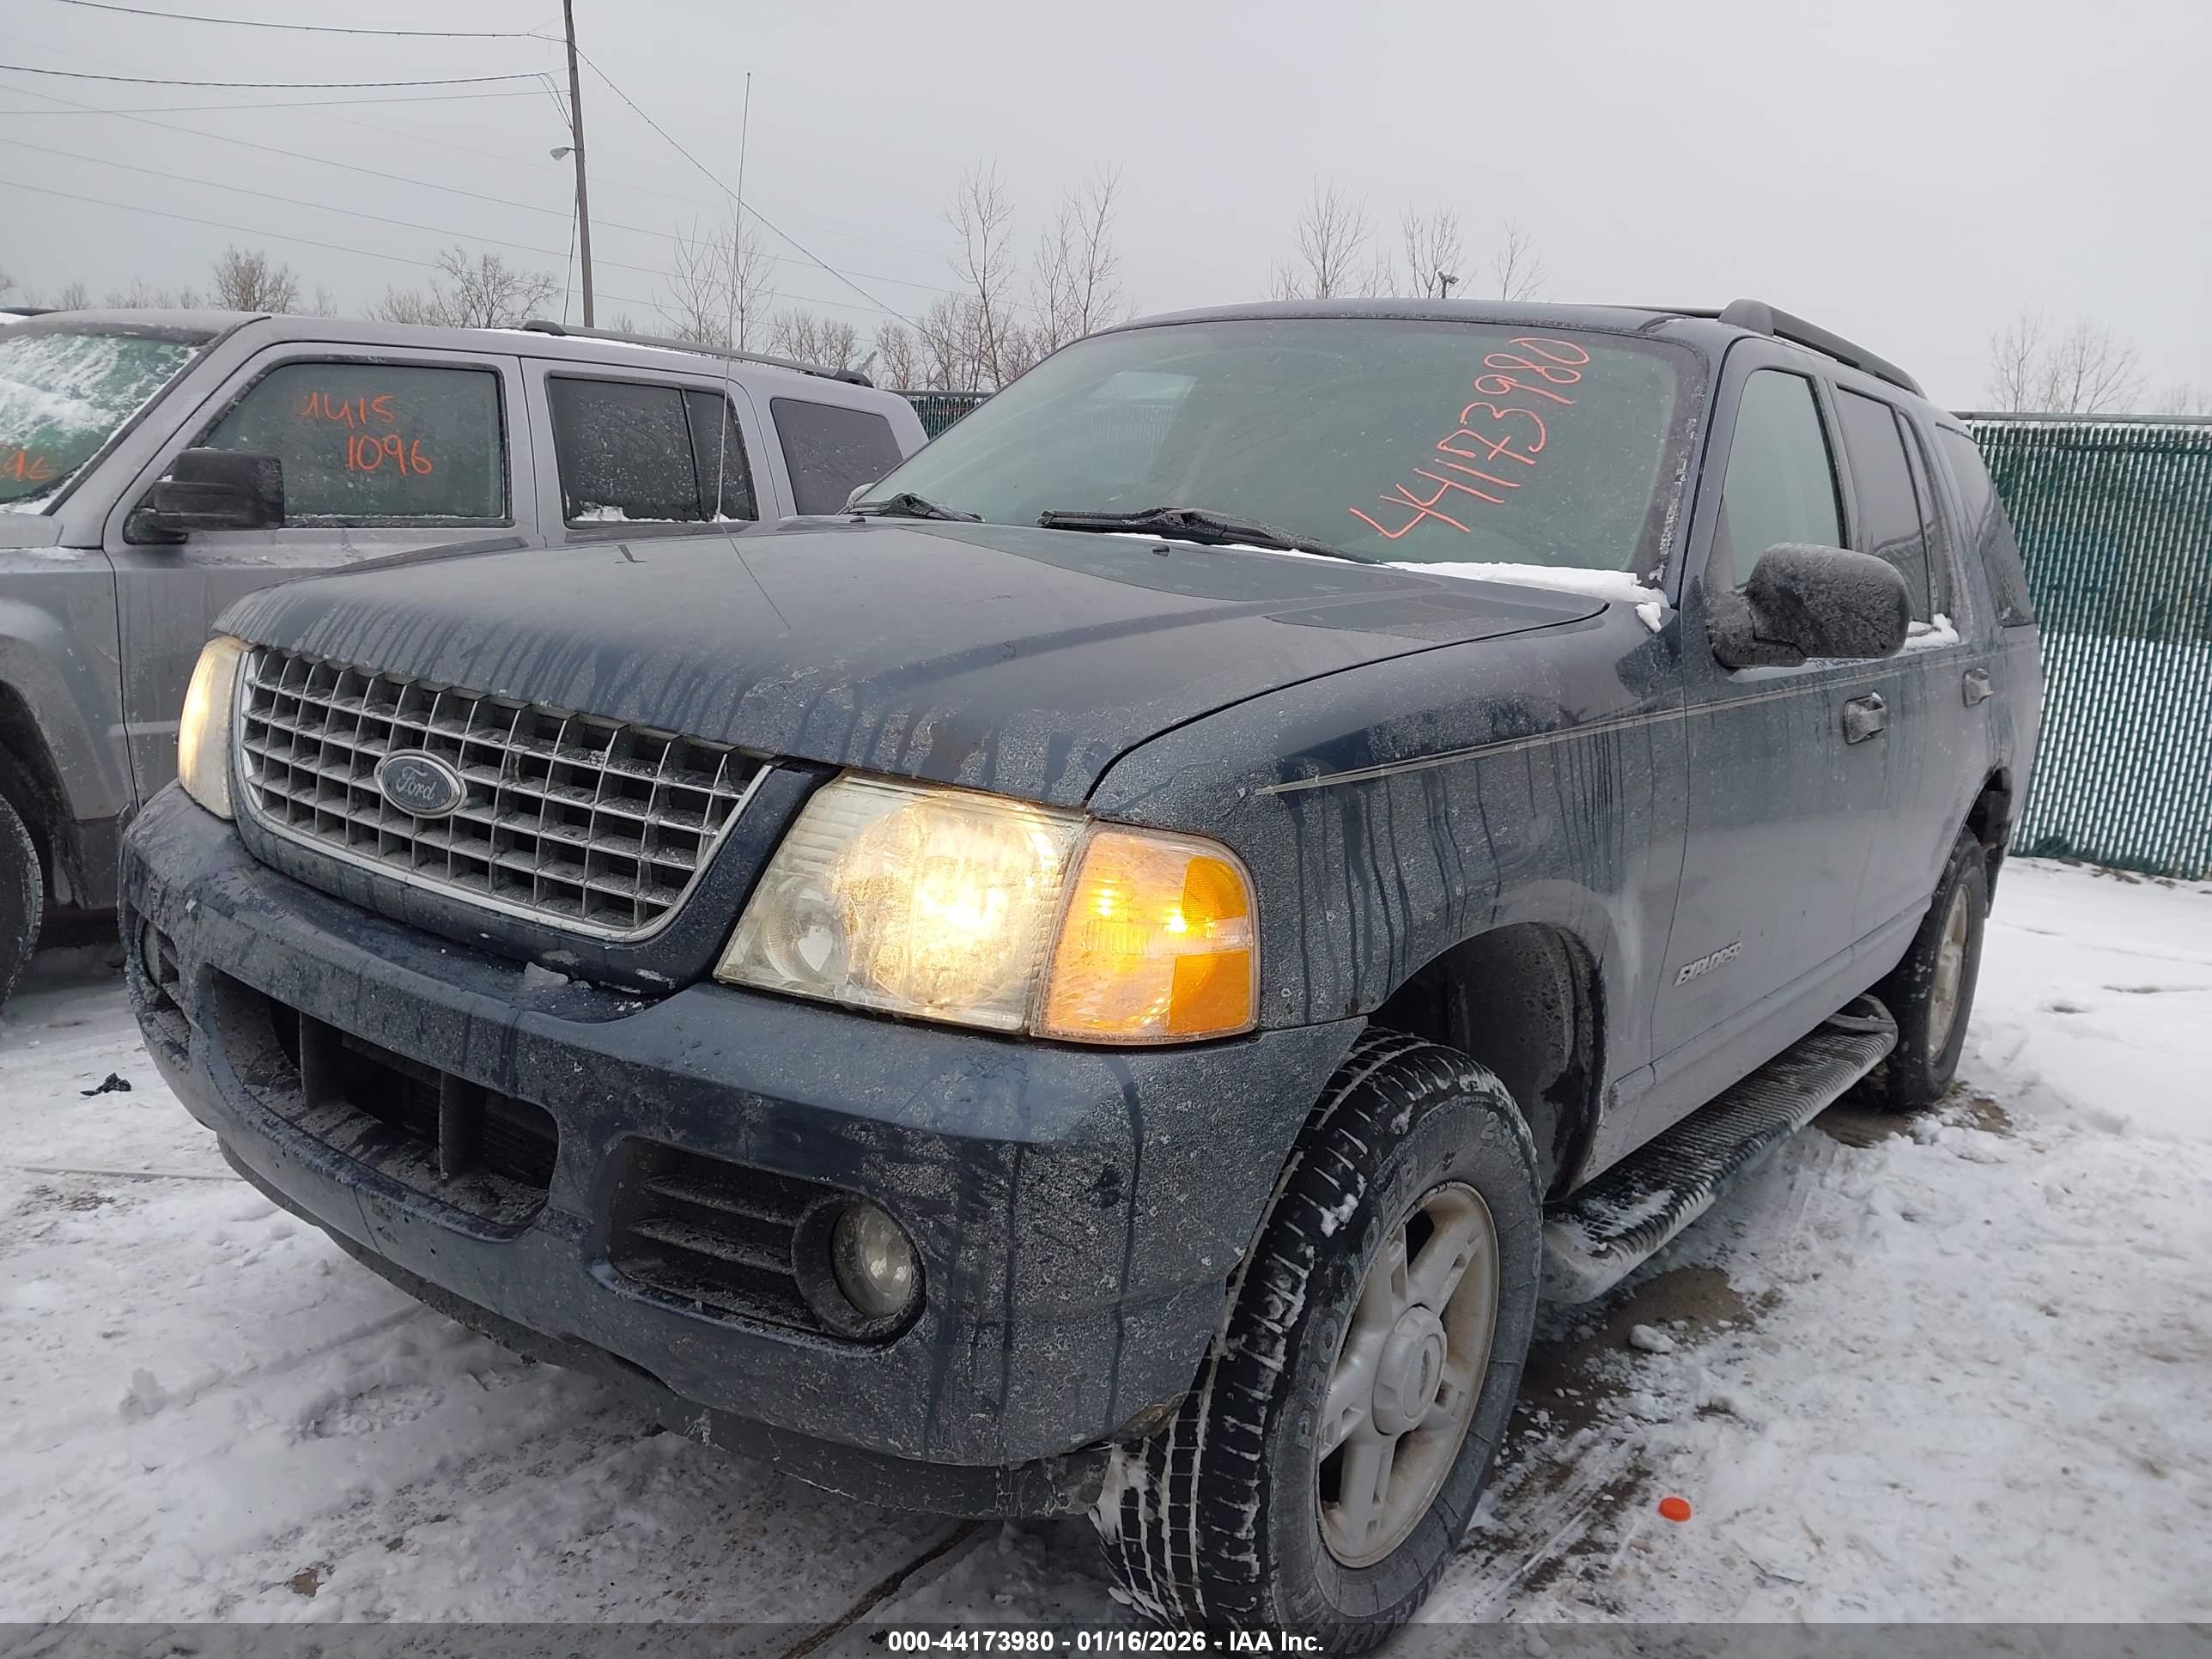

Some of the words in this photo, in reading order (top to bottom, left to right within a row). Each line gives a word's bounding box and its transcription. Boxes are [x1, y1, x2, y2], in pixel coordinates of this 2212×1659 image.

[347, 433, 433, 477] 1096
[1349, 337, 1590, 539] 44173980
[396, 766, 437, 801] Ford
[1674, 942, 1742, 988] EXPLORER
